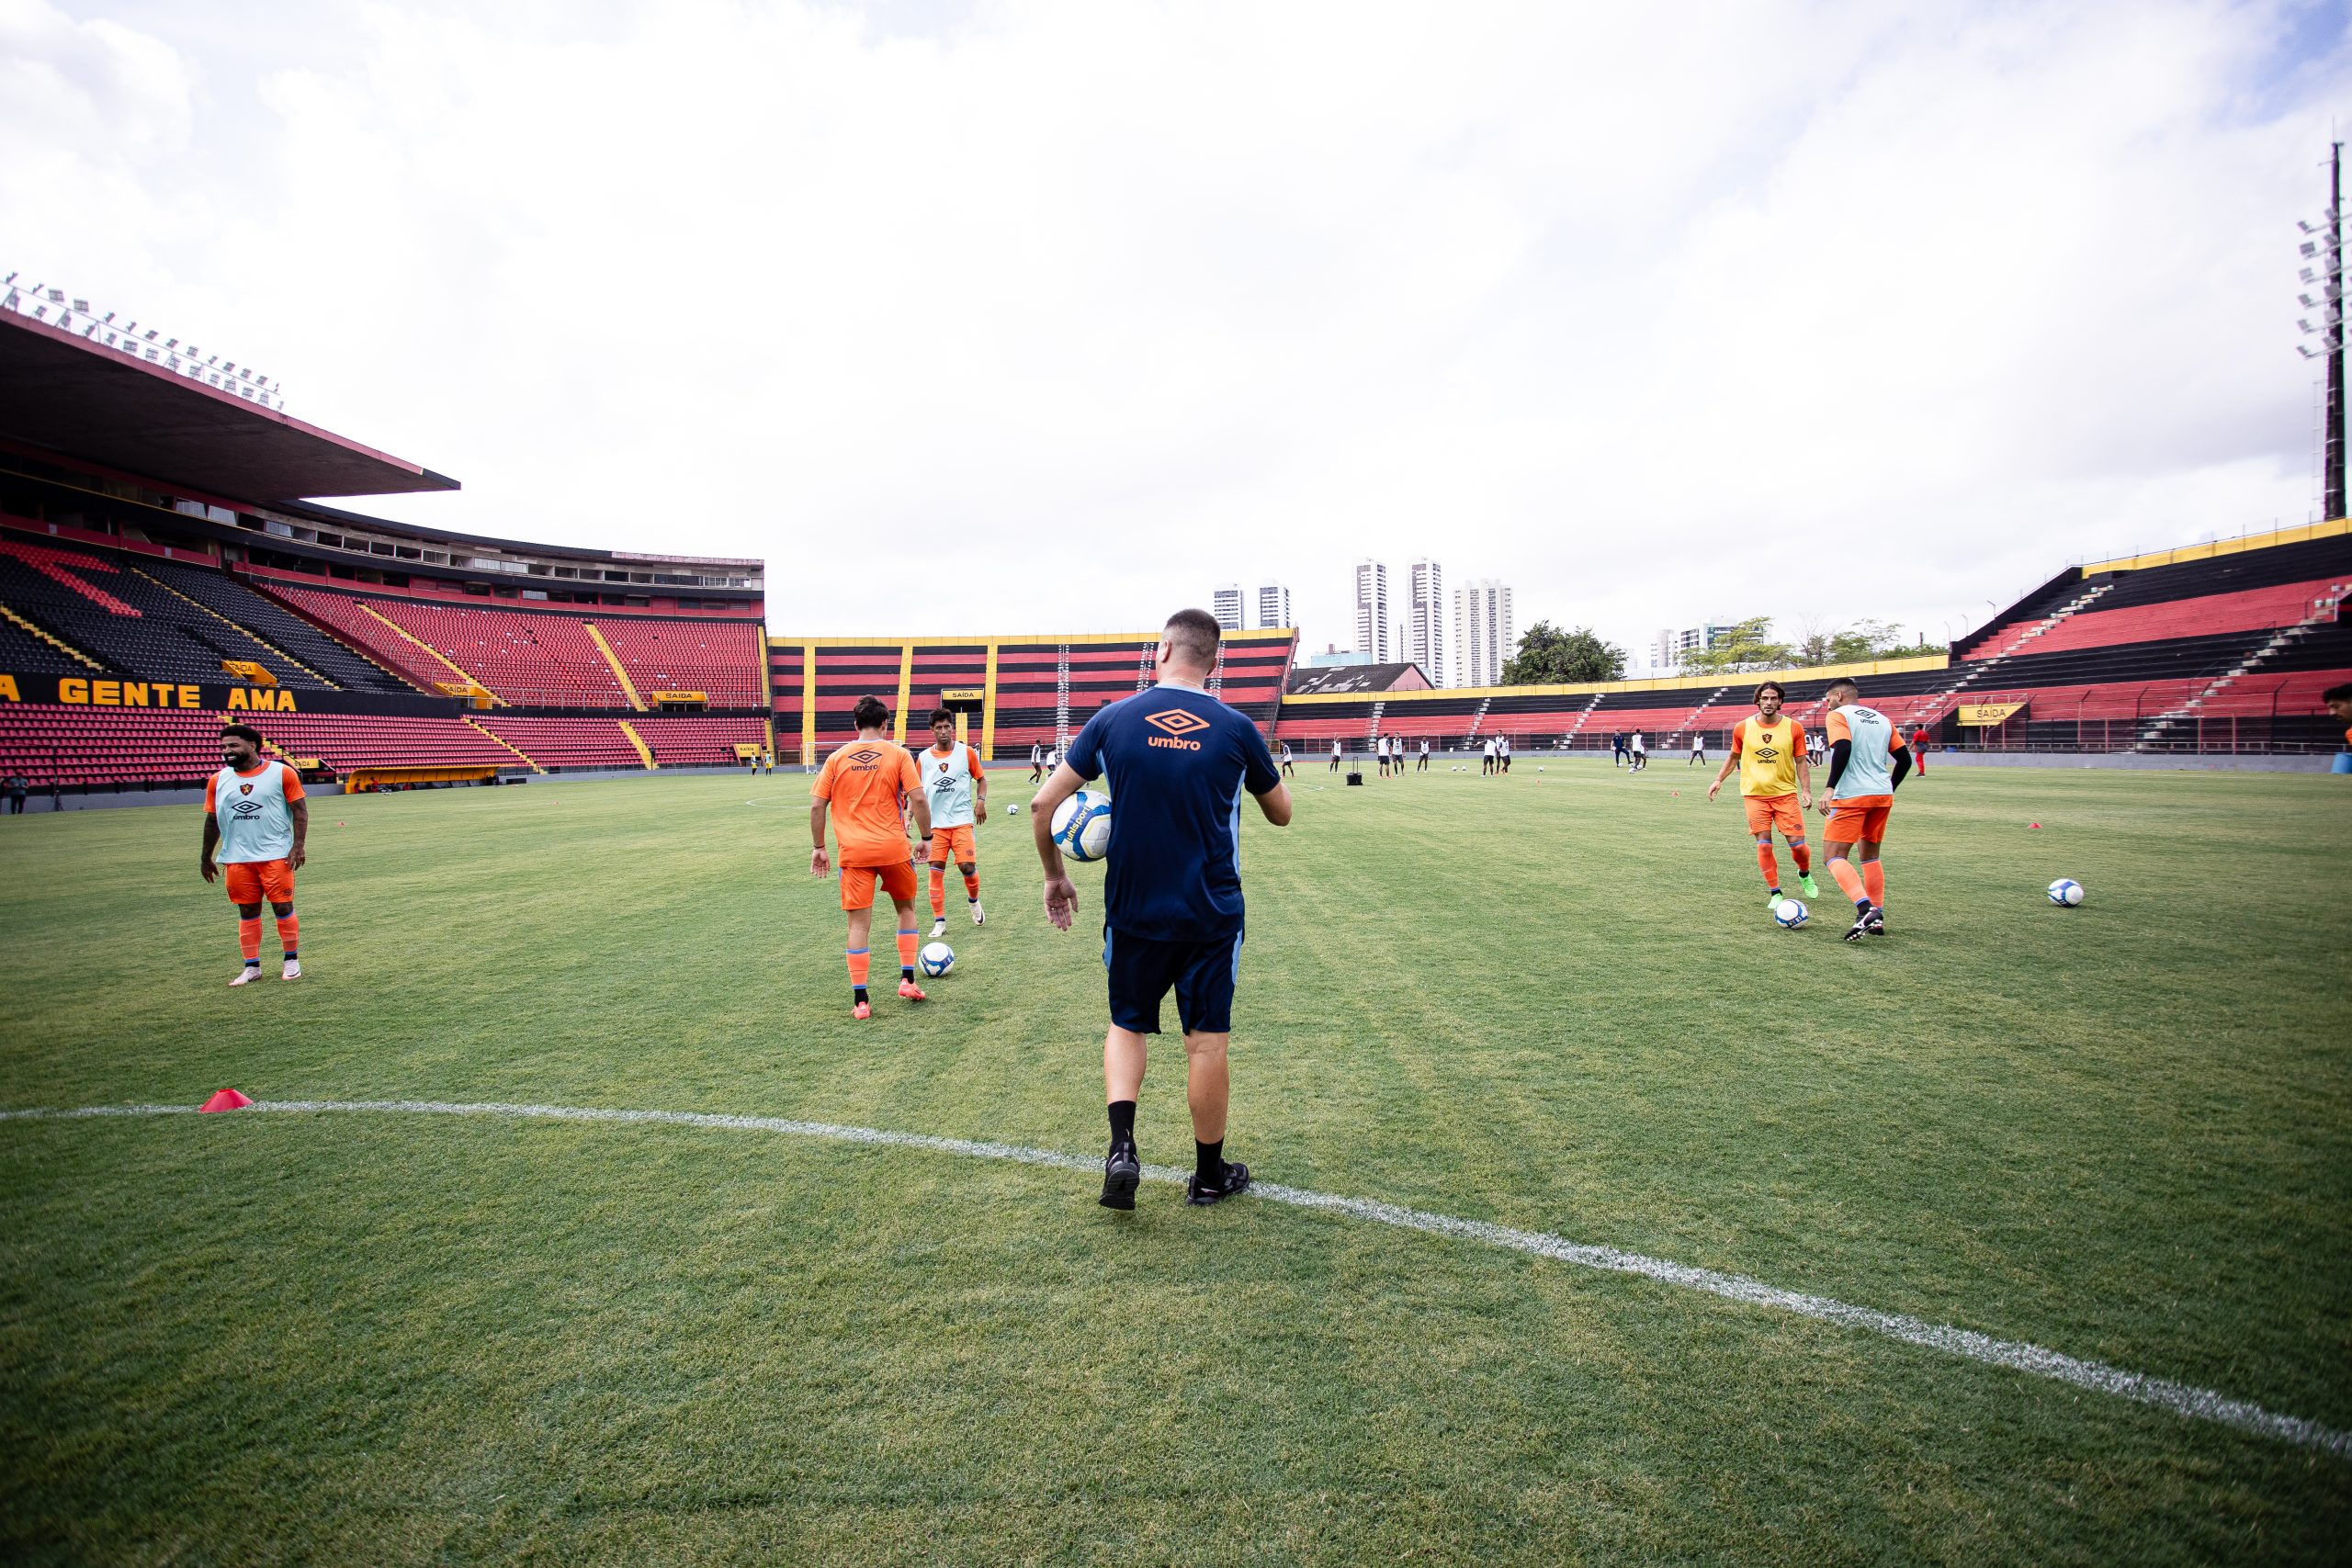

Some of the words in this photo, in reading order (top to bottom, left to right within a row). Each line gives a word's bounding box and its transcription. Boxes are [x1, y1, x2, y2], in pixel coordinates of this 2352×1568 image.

[59, 678, 201, 708] GENTE
[227, 688, 297, 712] AMA
[1976, 706, 2007, 718] SAÍDA
[1148, 736, 1201, 751] umbro
[851, 763, 878, 772] umbro
